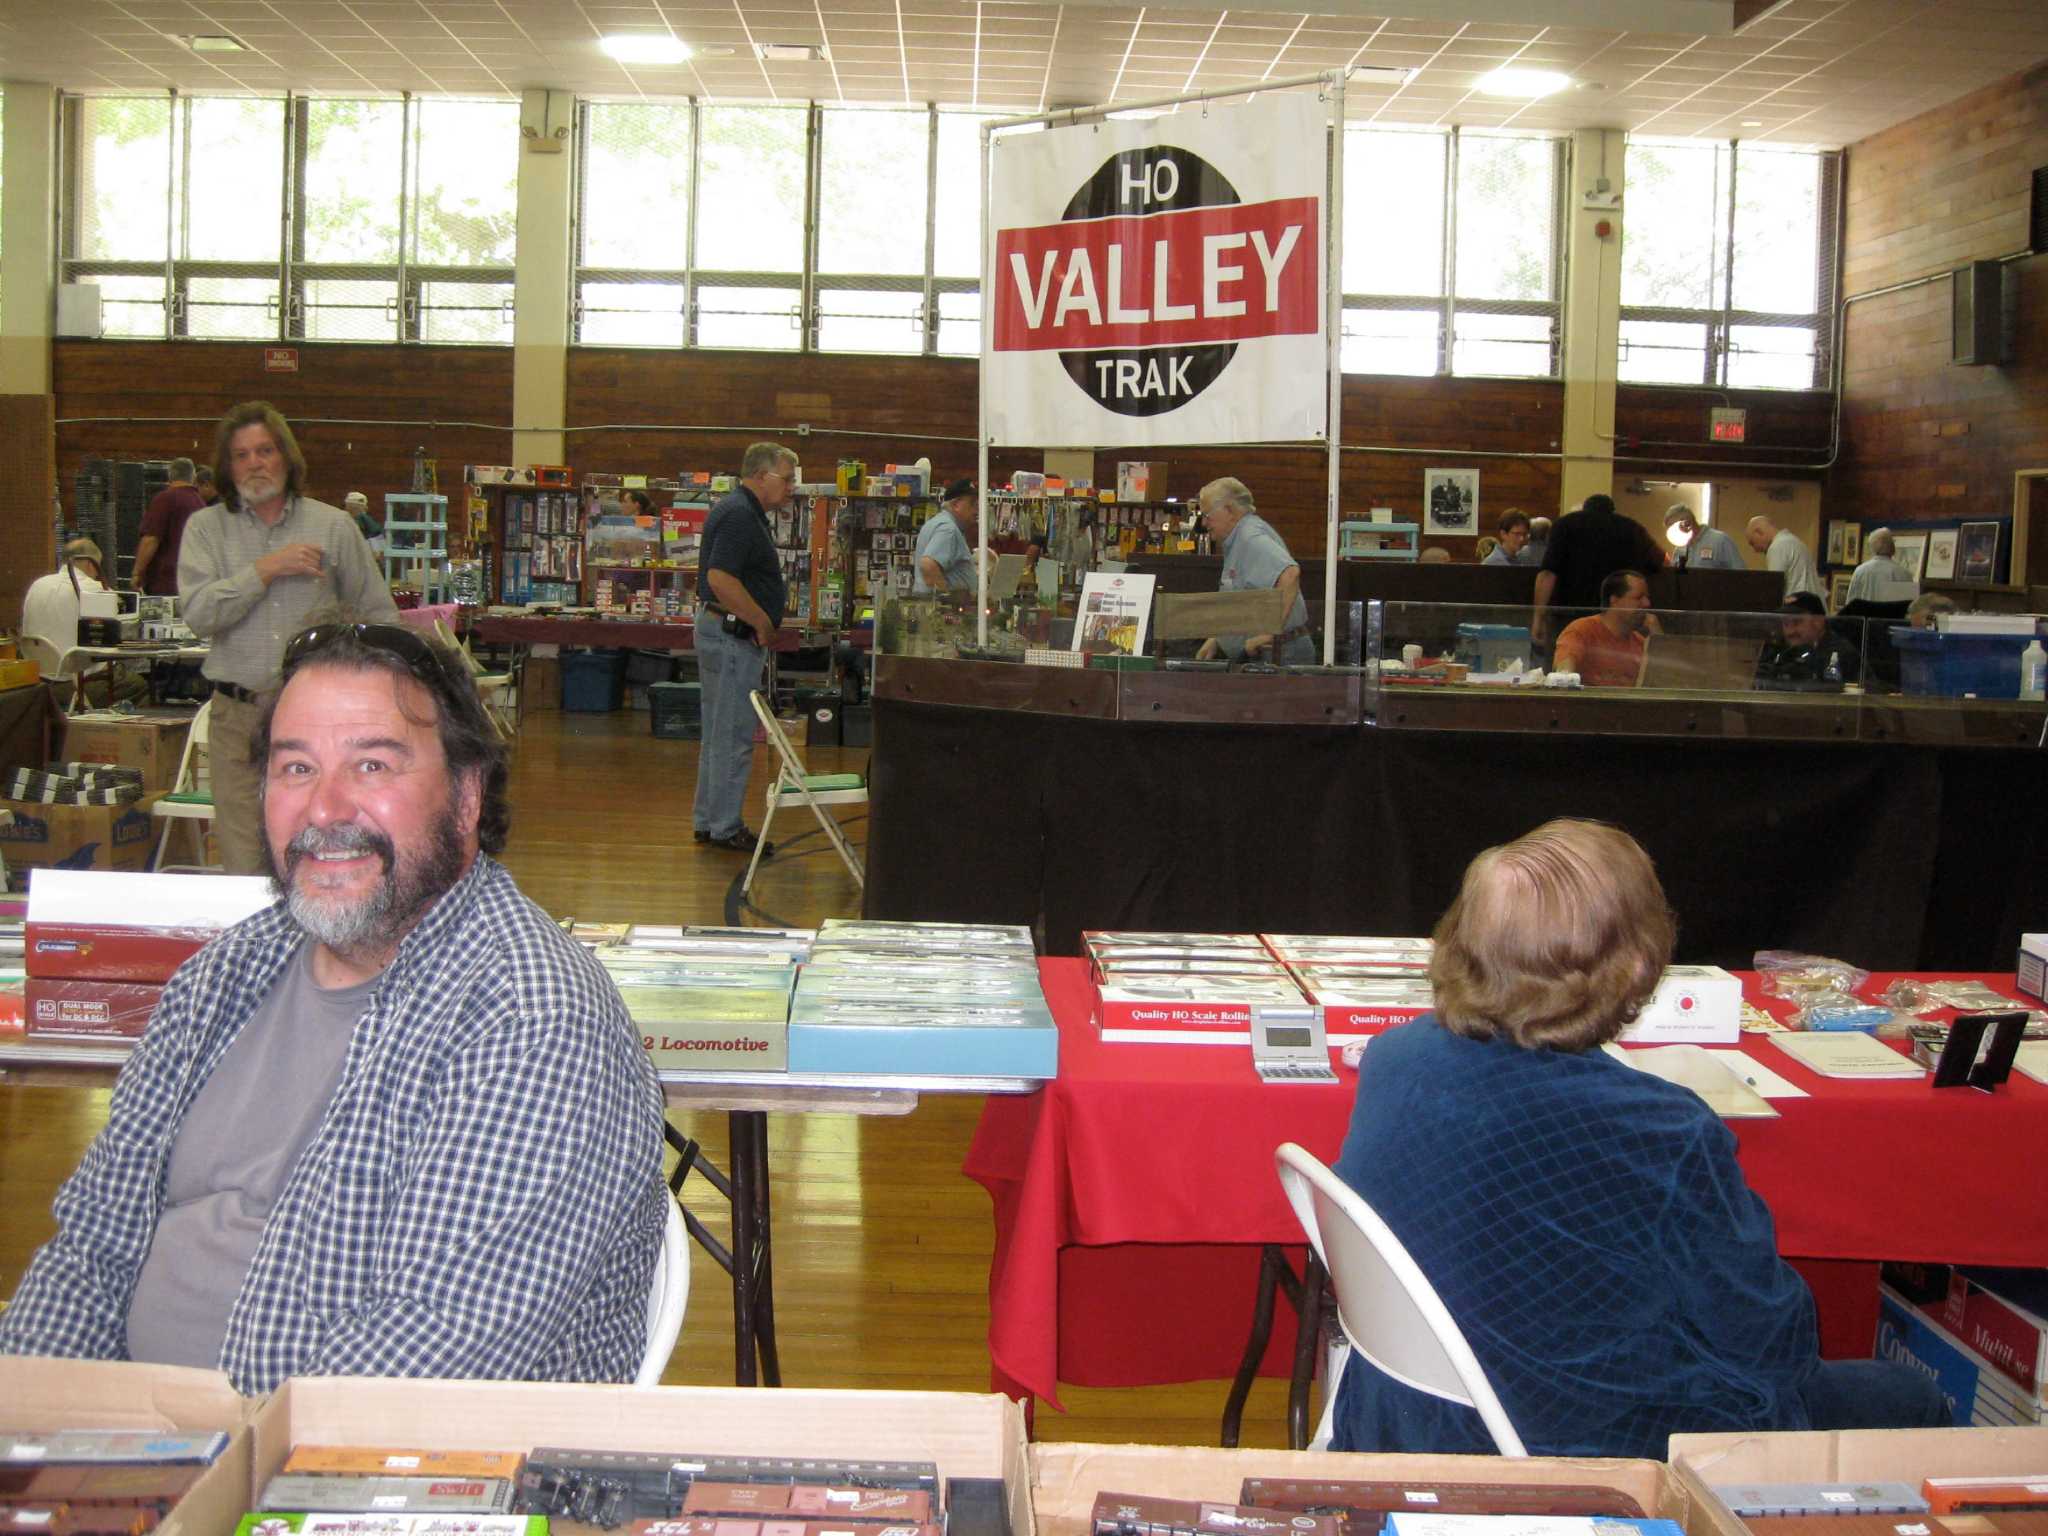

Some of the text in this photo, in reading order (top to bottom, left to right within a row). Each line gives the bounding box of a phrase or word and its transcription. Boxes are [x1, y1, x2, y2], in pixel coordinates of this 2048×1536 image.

[1120, 159, 1180, 205] HO
[1009, 225, 1303, 330] VALLEY
[1095, 355, 1194, 399] TRAK
[1131, 1010, 1169, 1021] Quality
[1172, 1011, 1189, 1019] HO
[1192, 1011, 1217, 1020] Scale
[1349, 1014, 1386, 1025] Quality
[1389, 1015, 1406, 1024] HO
[660, 1036, 769, 1051] Locomotive
